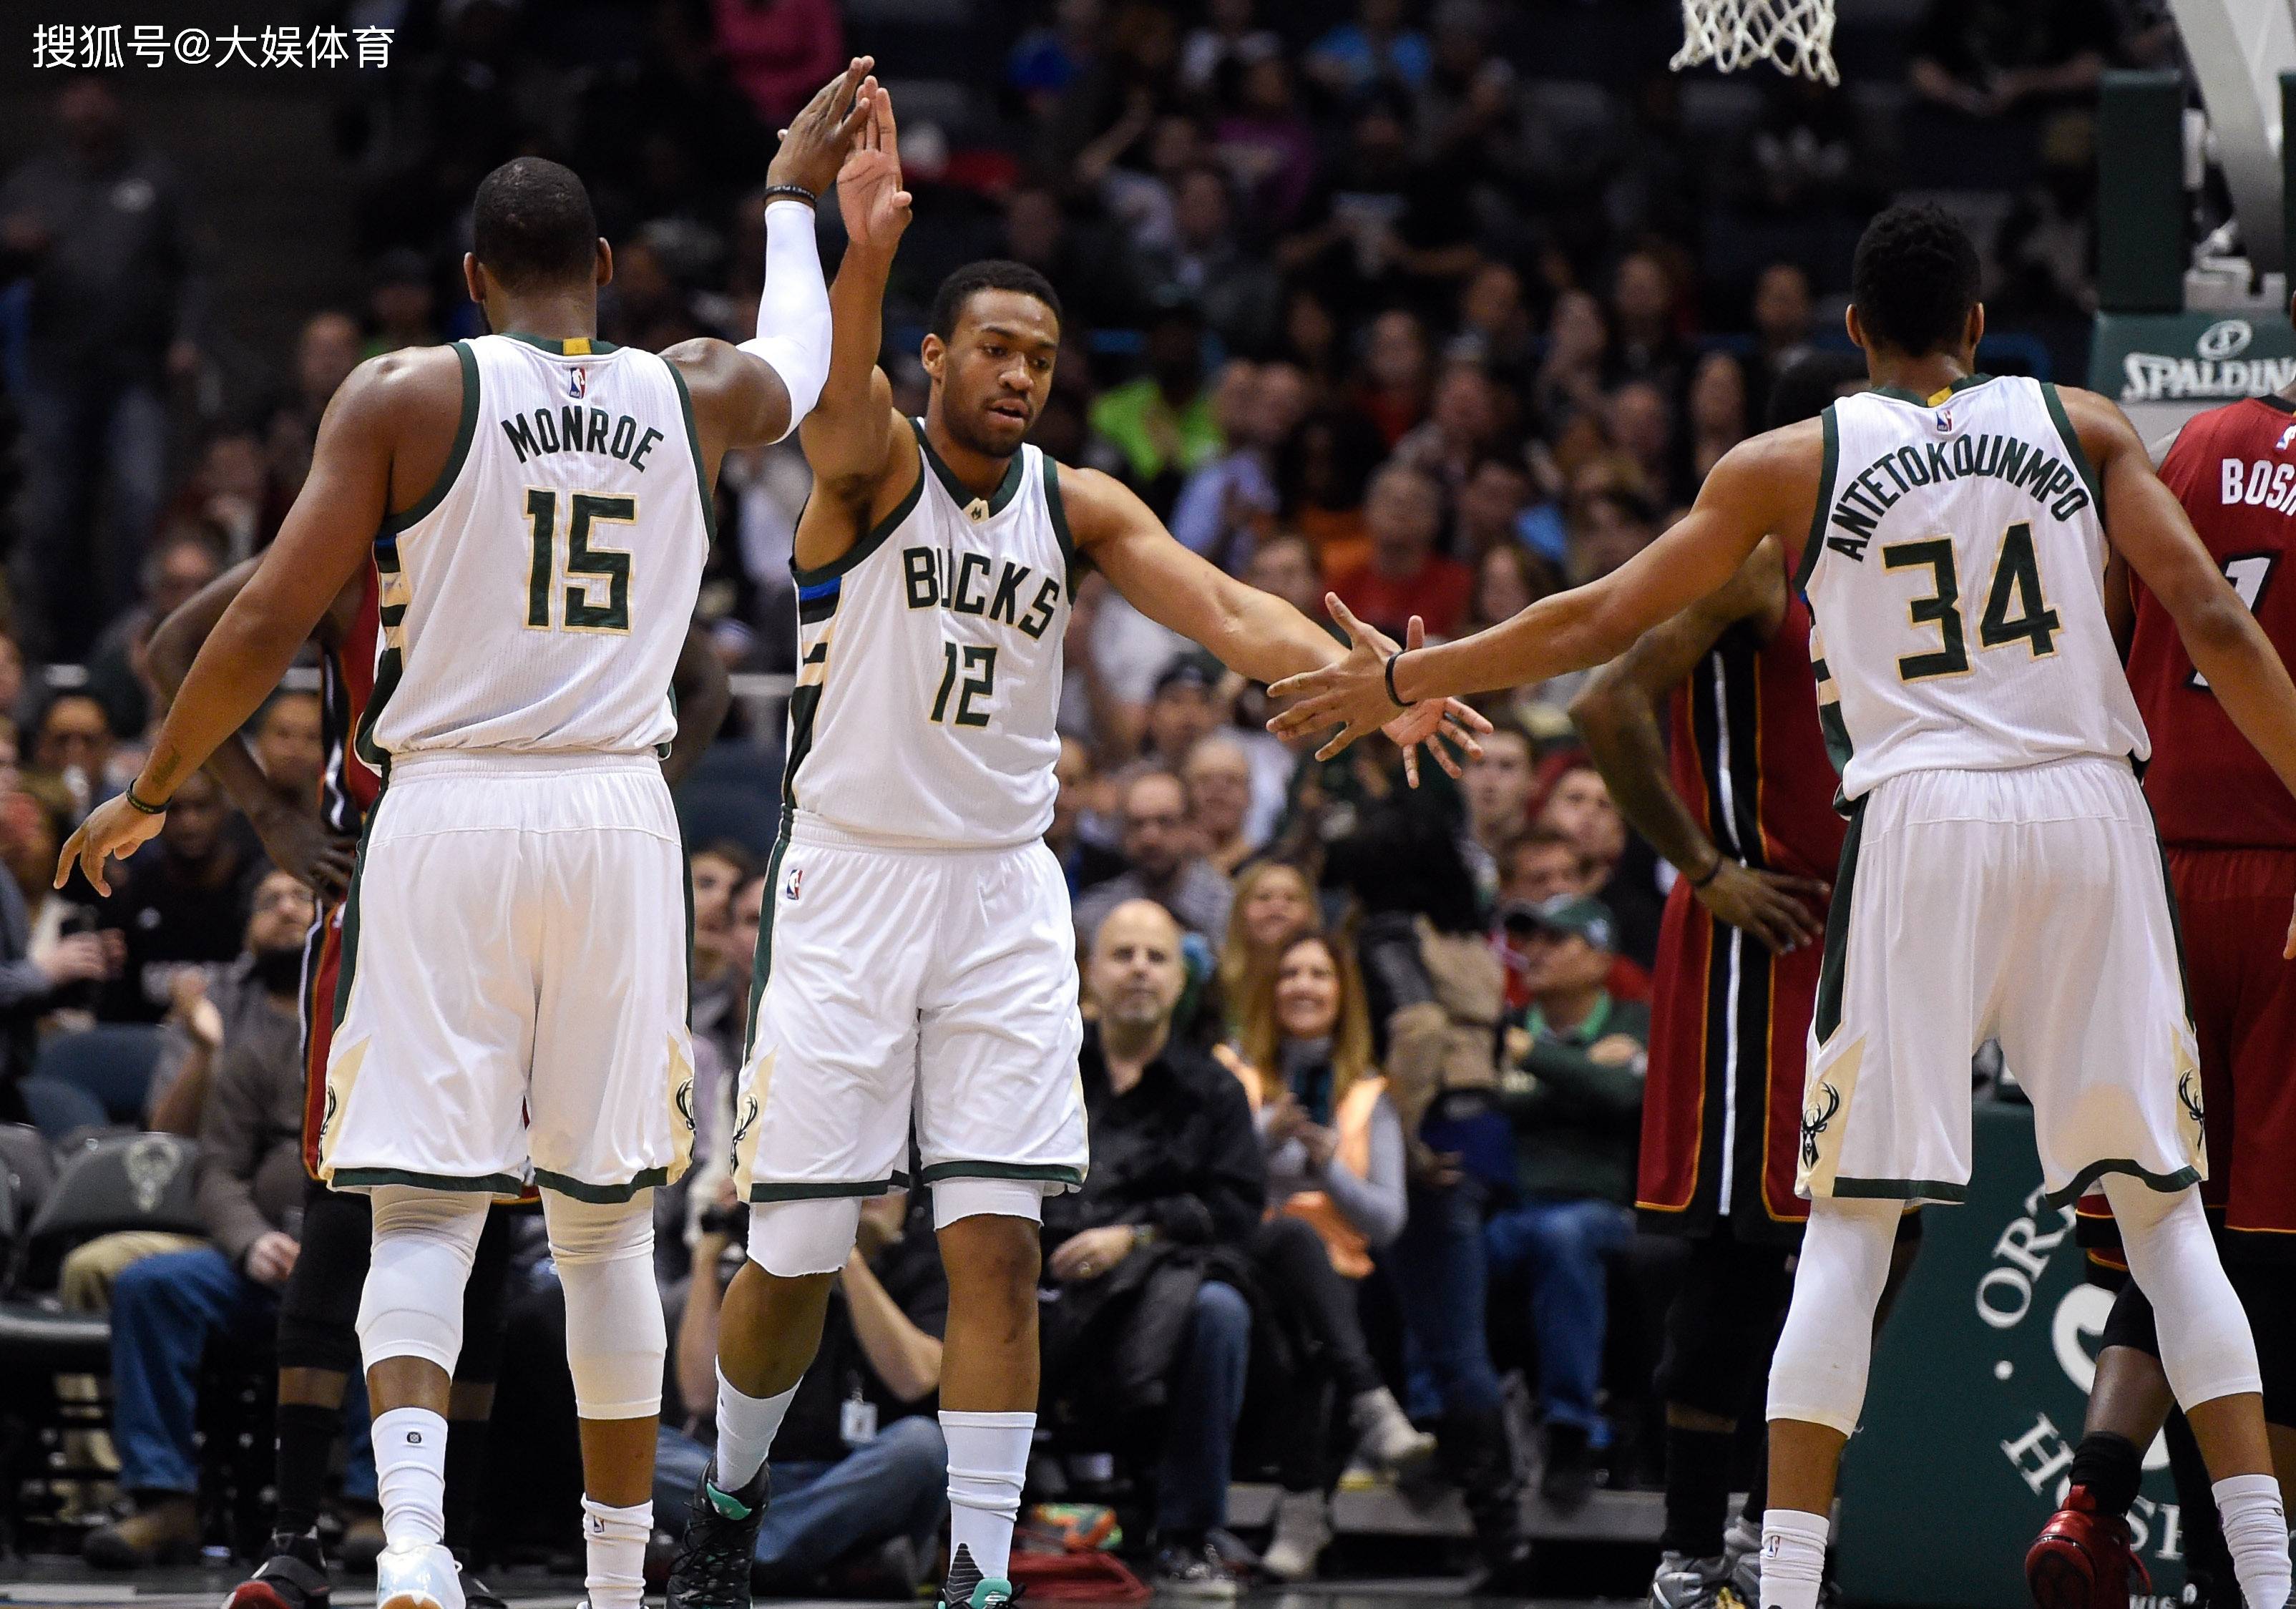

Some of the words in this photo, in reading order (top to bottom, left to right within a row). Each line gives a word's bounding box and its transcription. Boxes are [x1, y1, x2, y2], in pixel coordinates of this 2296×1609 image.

[2121, 351, 2296, 401] SPALDIN
[500, 405, 665, 473] MONROE
[1826, 434, 2089, 563] ANTETOKOUNMPO
[522, 484, 638, 637] 15
[902, 545, 1060, 640] BUCKS
[1880, 519, 2064, 685] 34
[929, 640, 998, 728] 12
